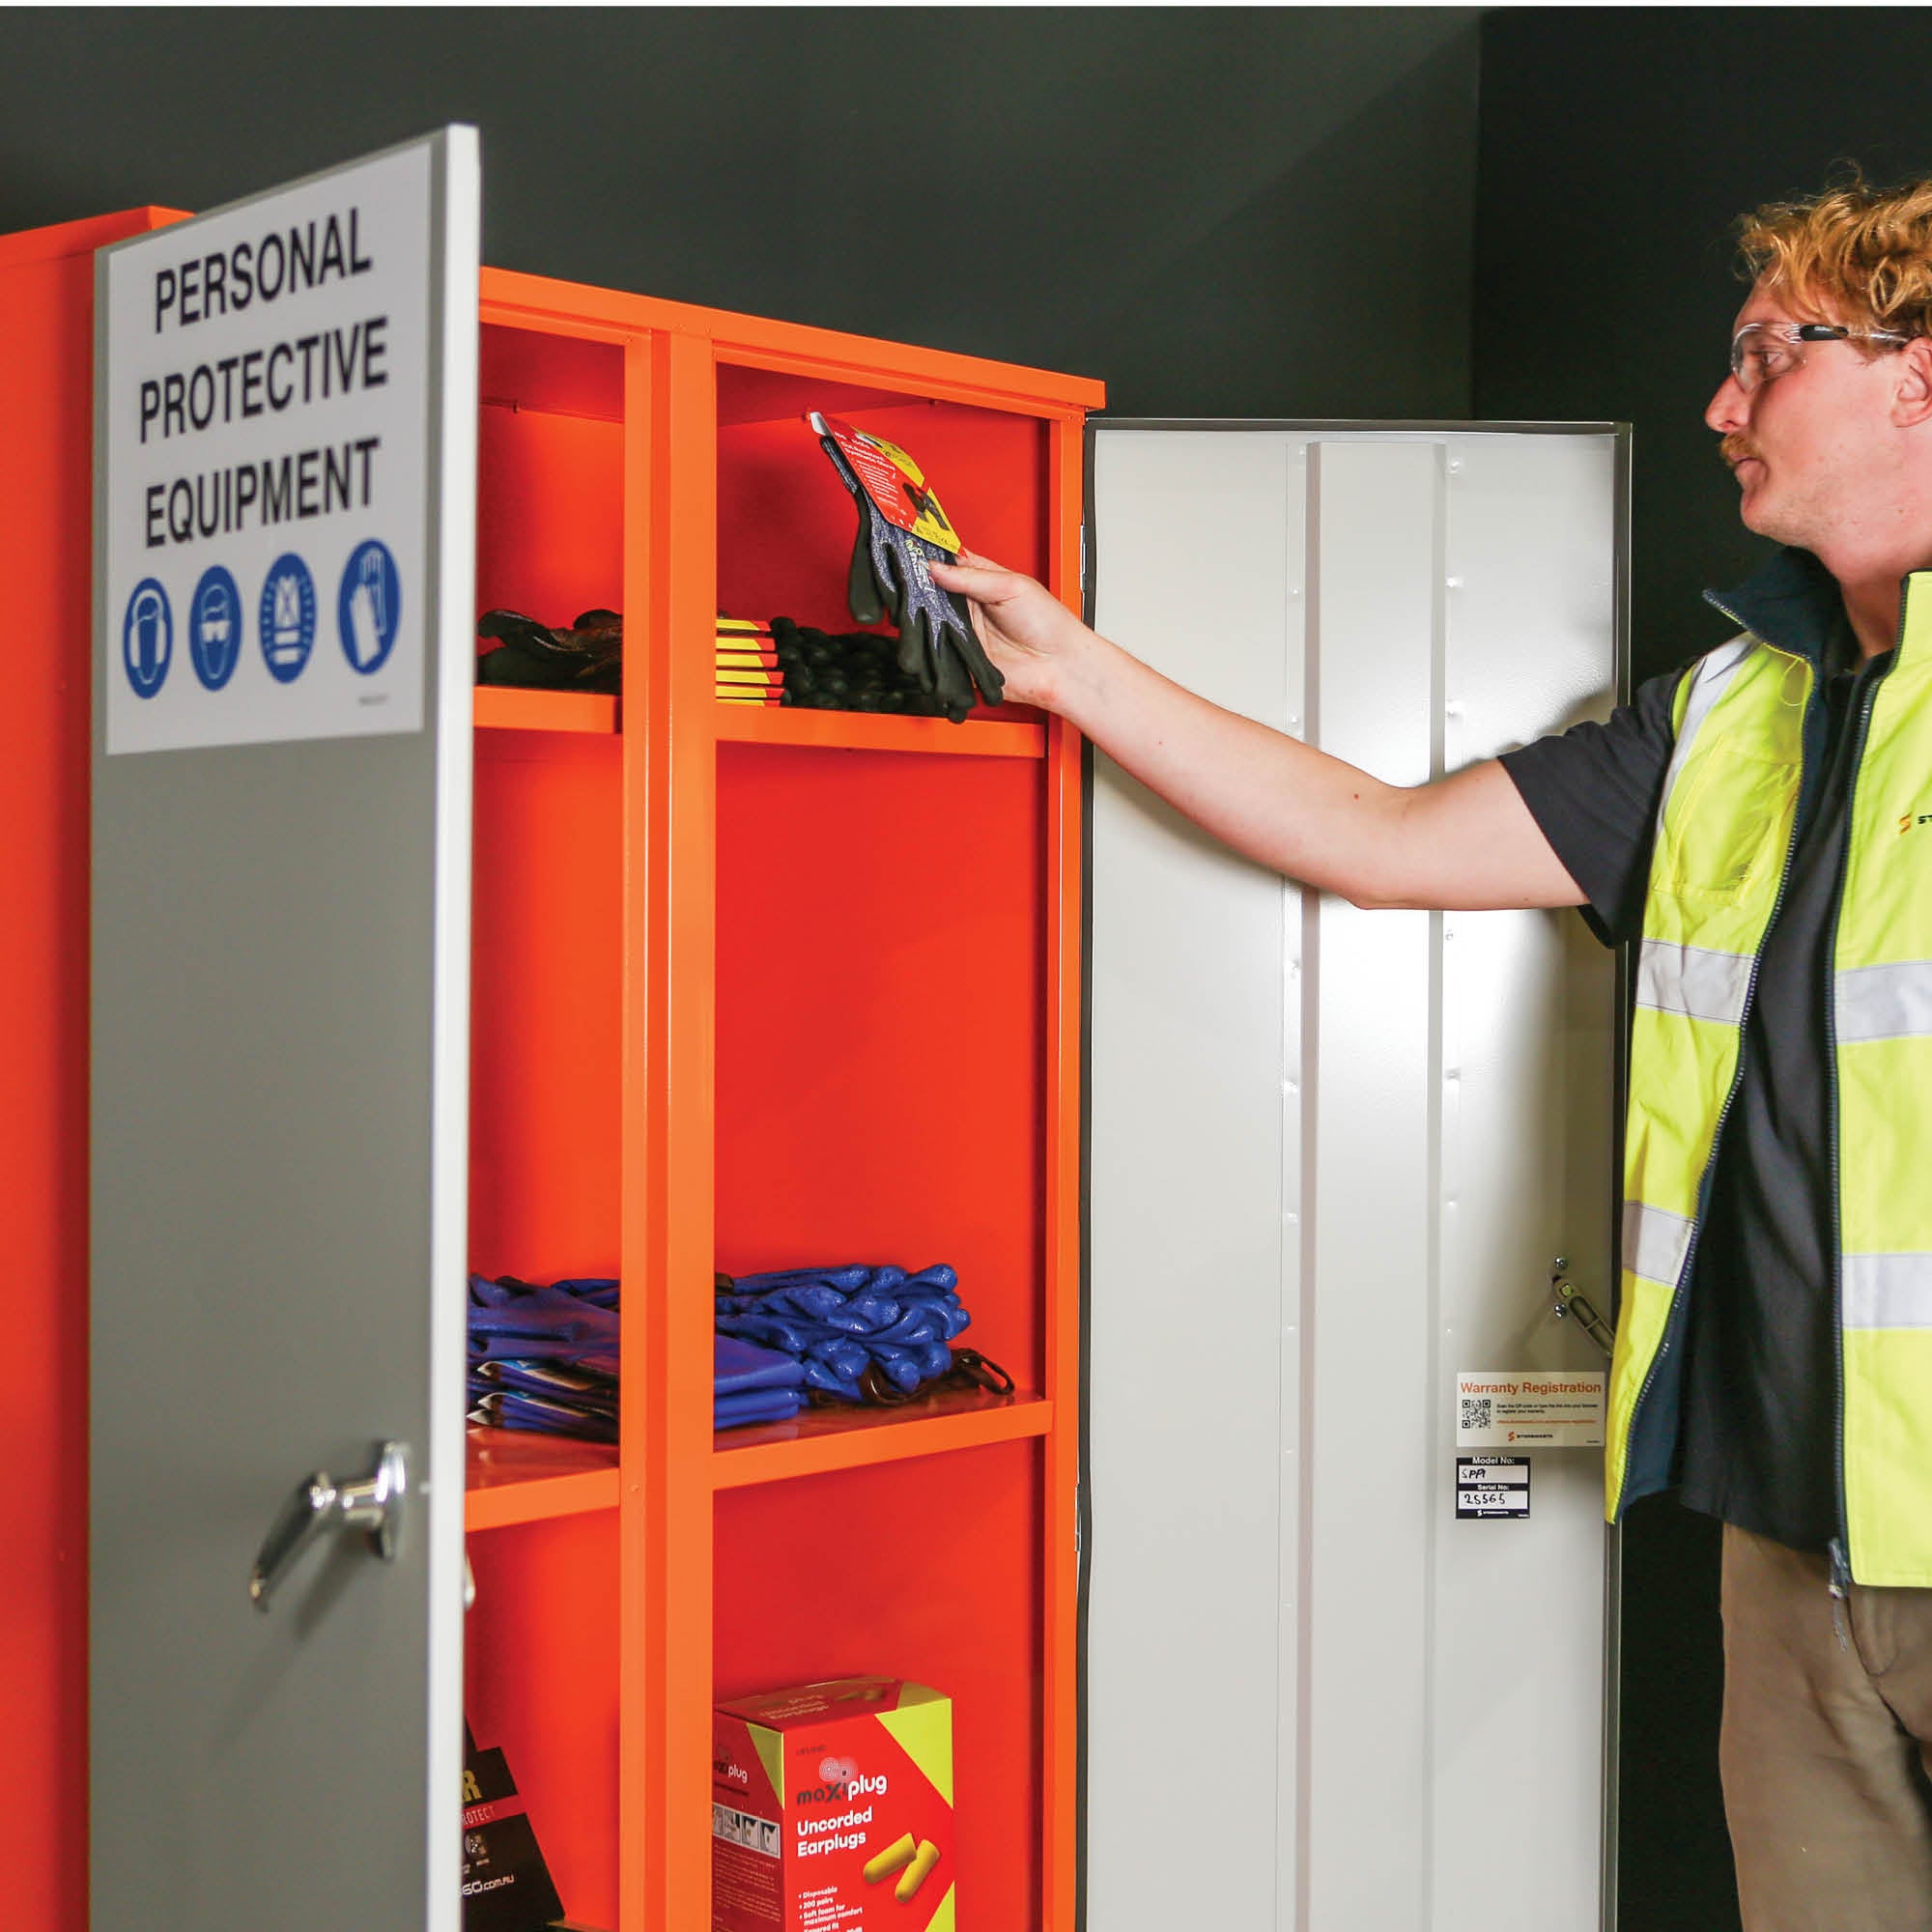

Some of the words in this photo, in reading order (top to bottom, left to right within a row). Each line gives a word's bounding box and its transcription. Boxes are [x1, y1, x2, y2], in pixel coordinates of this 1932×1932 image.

[155, 206, 374, 334] PERSONAL
[140, 315, 388, 444] PROTECTIVE
[145, 436, 383, 549] EQUIPMENT
[1460, 1381, 1519, 1395] Warranty
[1522, 1381, 1602, 1395] Registration
[797, 1805, 873, 1836] Uncorded
[797, 1831, 867, 1858] Earplugs
[803, 1886, 838, 1898] Disposable
